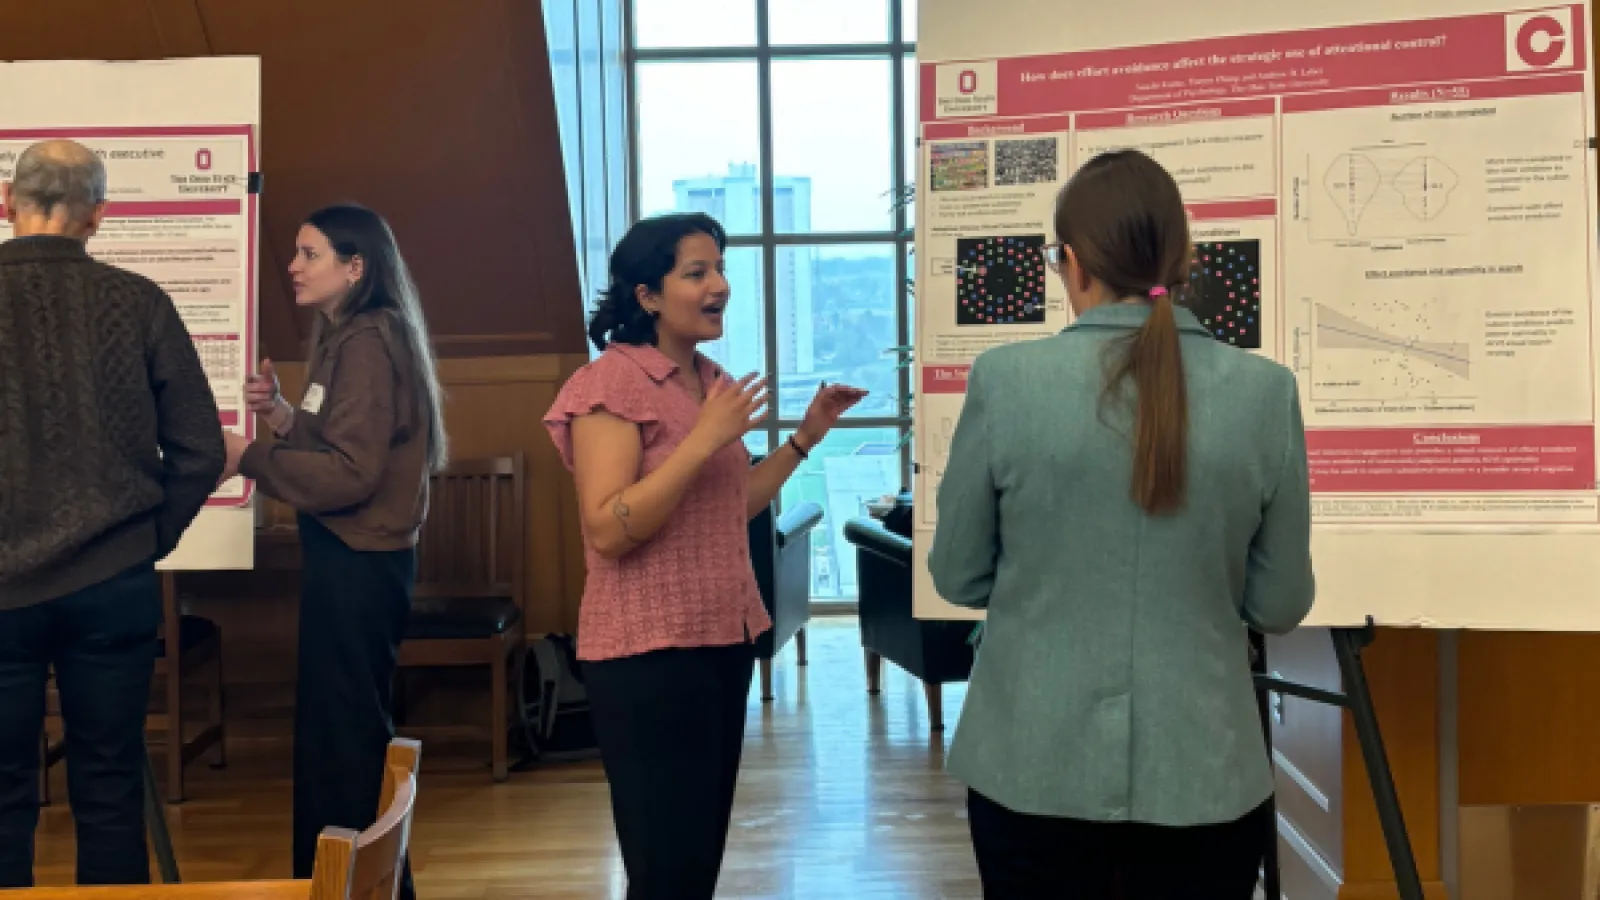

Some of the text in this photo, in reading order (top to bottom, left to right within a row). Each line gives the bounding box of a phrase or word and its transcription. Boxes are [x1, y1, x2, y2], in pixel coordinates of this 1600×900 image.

[1515, 15, 1566, 67] C
[1020, 34, 1447, 83] How does effort avoidance affect the strategic use of attentional control?
[958, 70, 977, 94] O
[109, 148, 165, 160] executive
[195, 148, 212, 171] O
[1412, 432, 1481, 445] Conclusions
